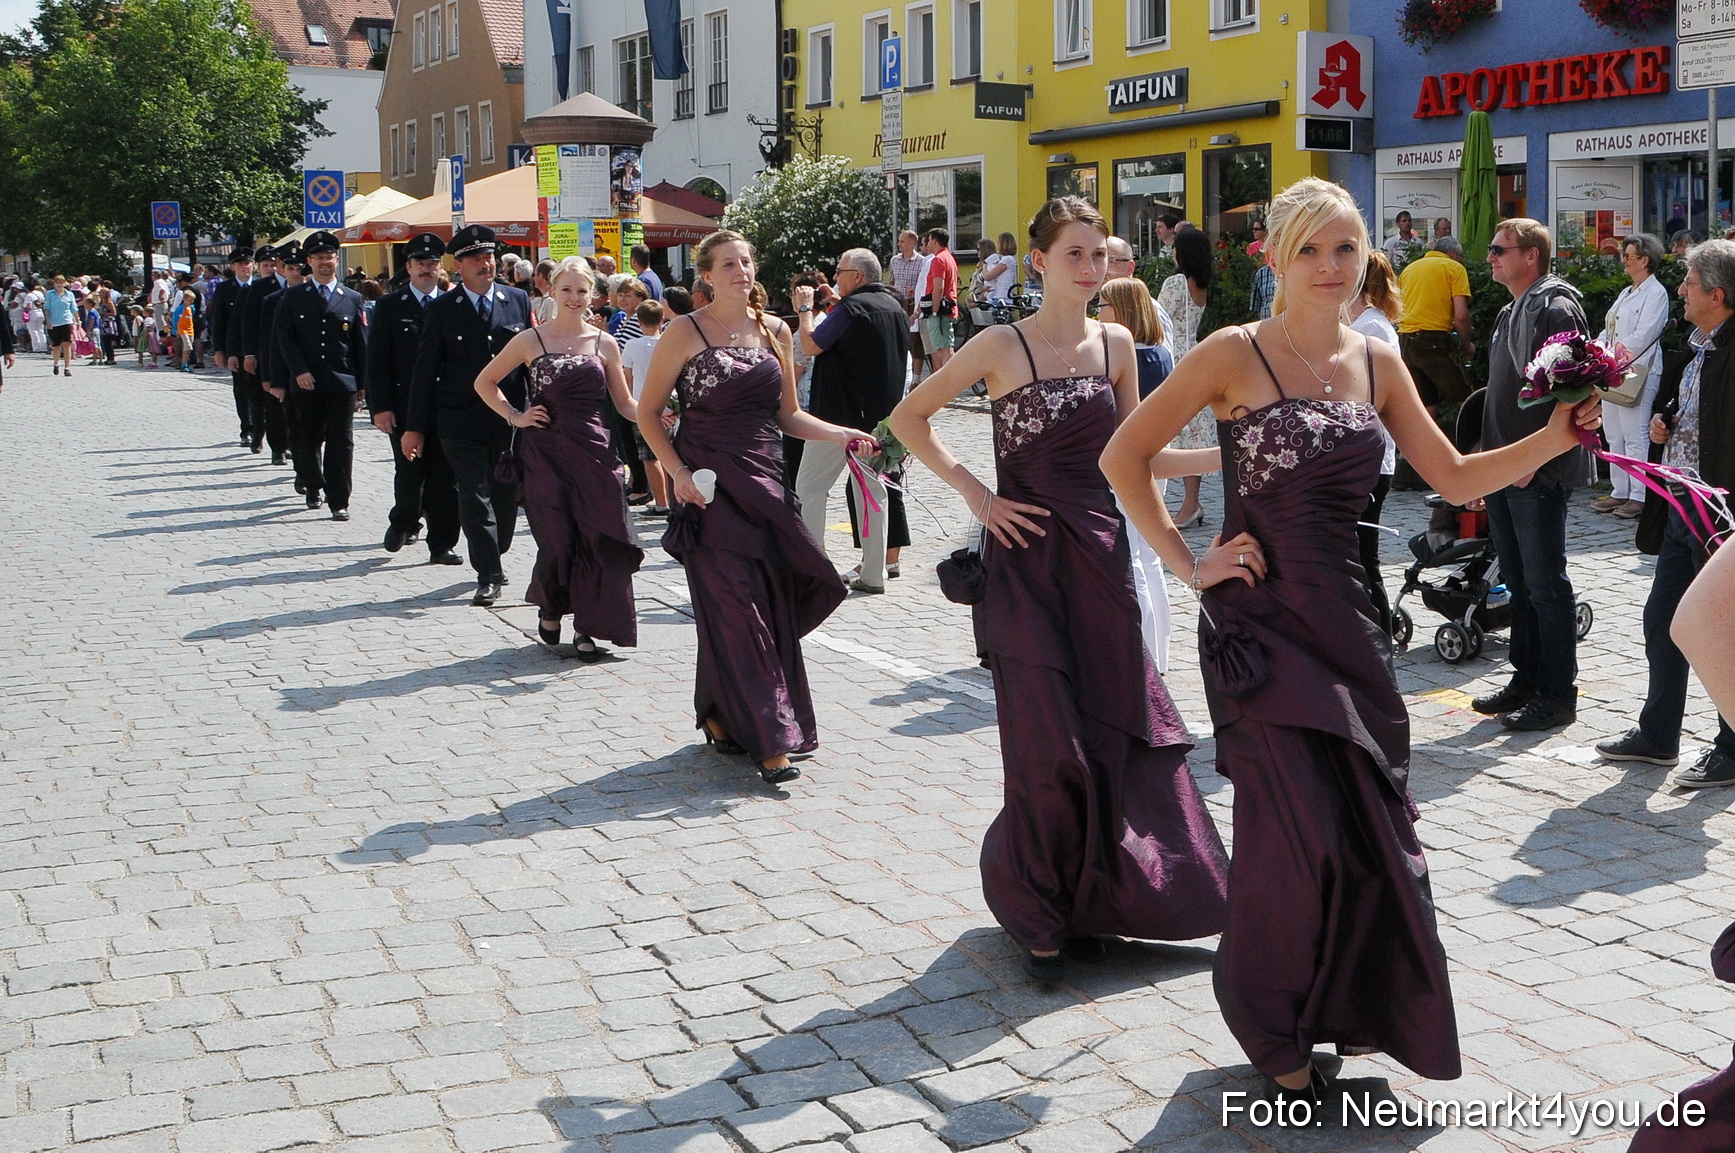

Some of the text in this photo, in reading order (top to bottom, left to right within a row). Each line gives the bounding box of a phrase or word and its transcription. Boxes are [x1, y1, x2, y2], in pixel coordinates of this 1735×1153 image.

[1681, 19, 1692, 29] Sa
[886, 44, 897, 83] P
[1104, 74, 1177, 106] TAIFUN
[1413, 45, 1671, 119] APOTHEKE
[979, 104, 1023, 116] TAIFUN
[1576, 128, 1707, 153] RATHAUS APOTHEKE
[1397, 144, 1504, 167] RATHAUS APKE
[452, 161, 461, 193] P
[309, 211, 341, 224] TAXI
[156, 227, 178, 236] TAXI
